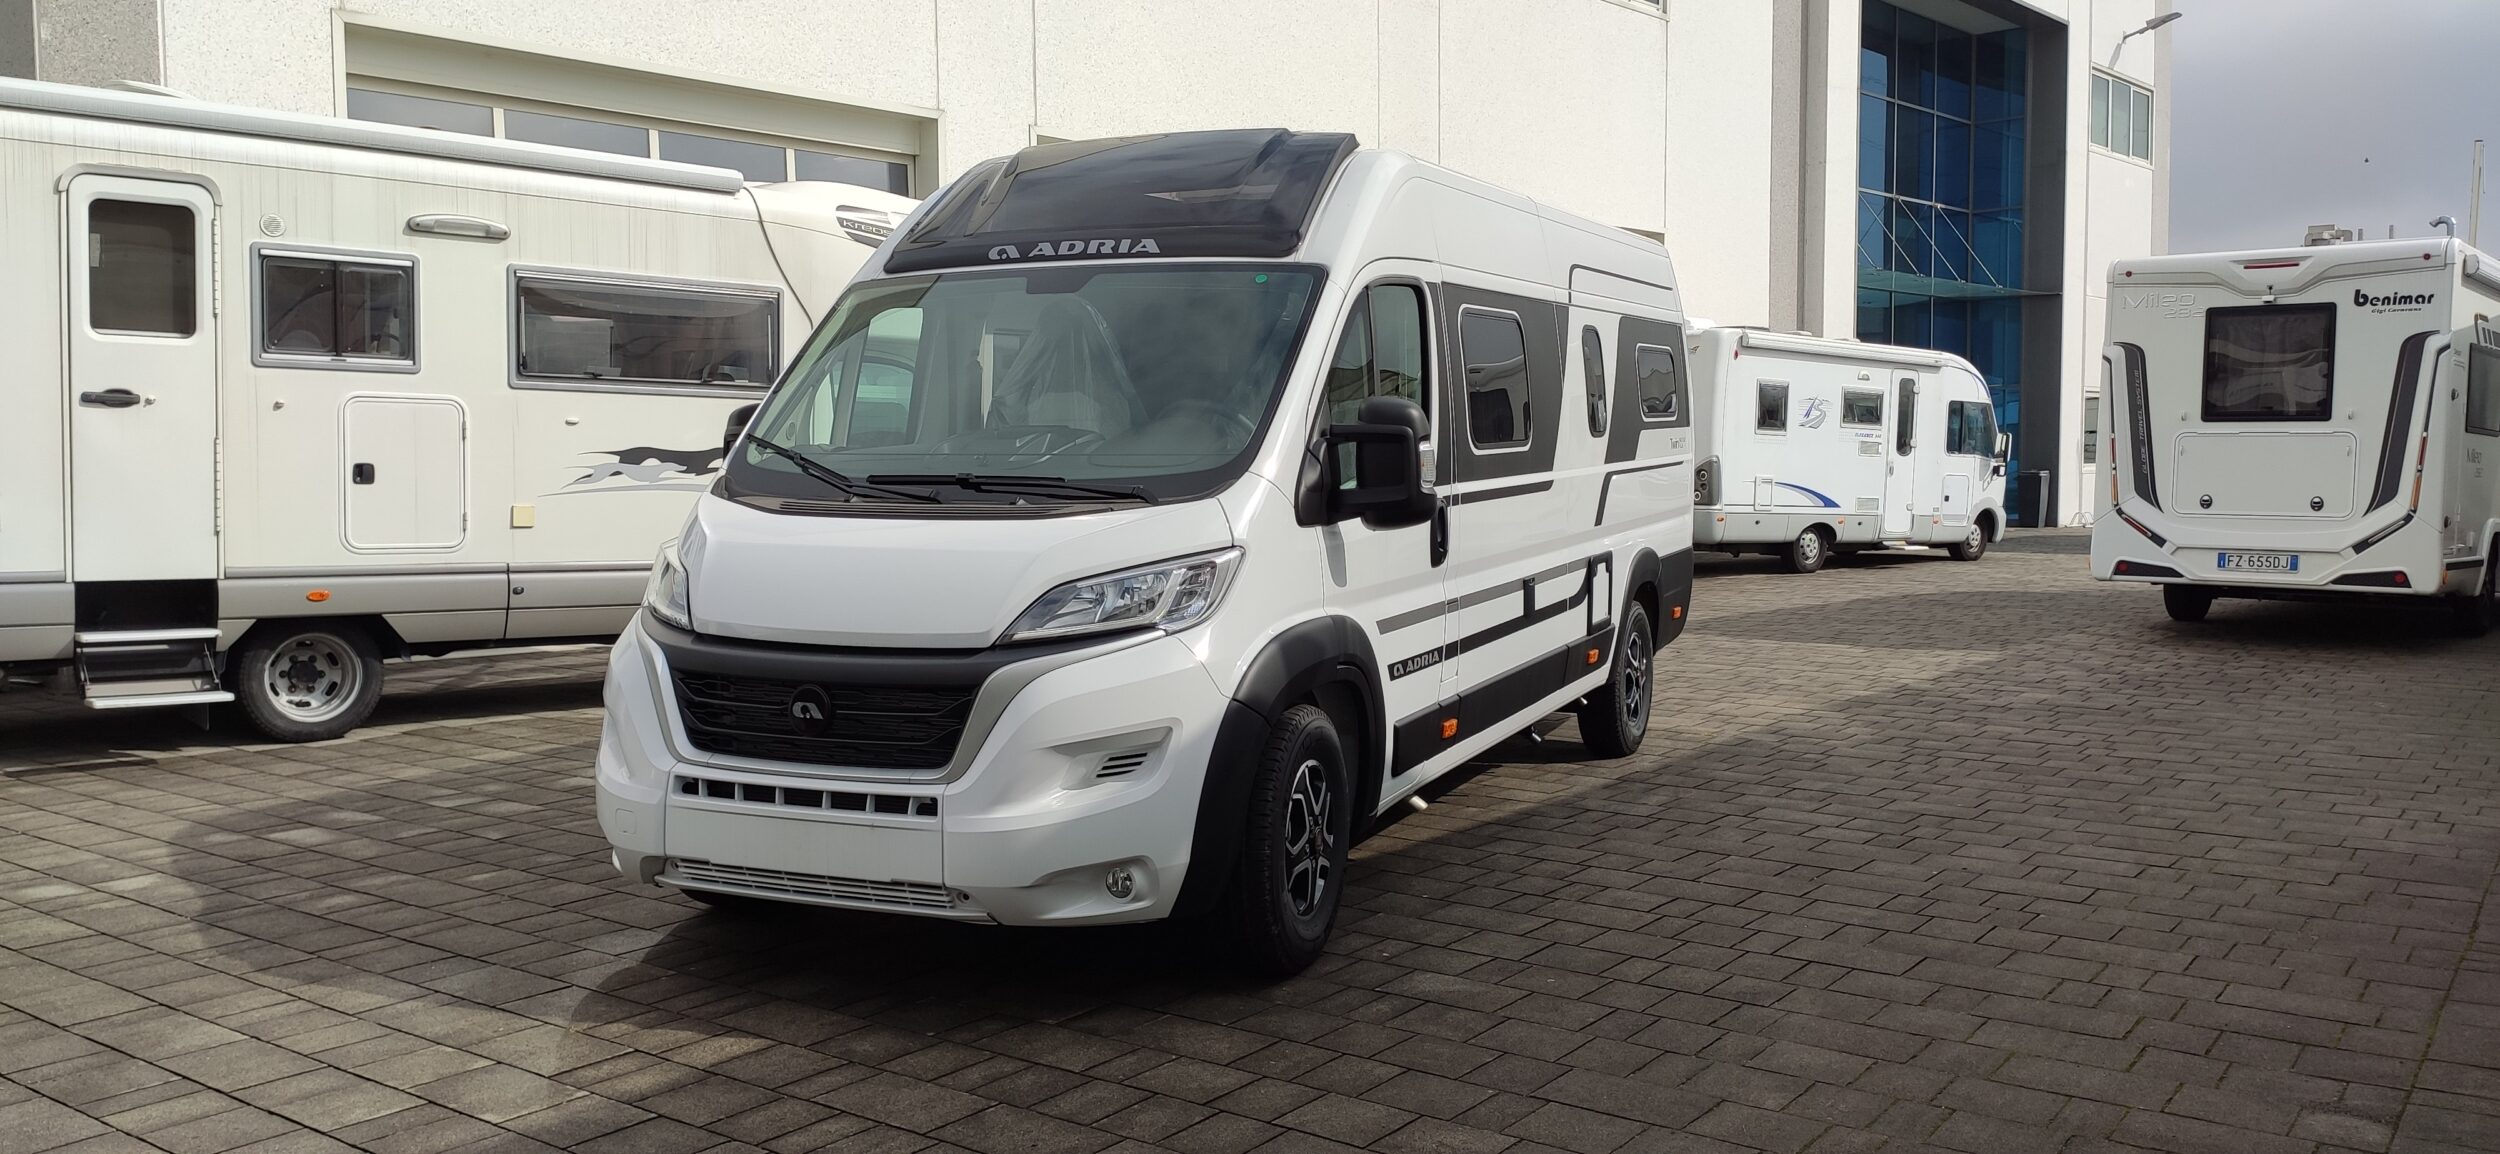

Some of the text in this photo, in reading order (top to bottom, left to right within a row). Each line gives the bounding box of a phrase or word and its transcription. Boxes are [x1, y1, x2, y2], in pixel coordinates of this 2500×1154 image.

[1027, 239, 1161, 257] ADRIA
[2122, 291, 2196, 309] Mileo
[2353, 289, 2435, 307] benimar
[2227, 555, 2243, 567] FZ
[2247, 555, 2290, 569] 655DJ
[1405, 650, 1440, 673] ADRIA
